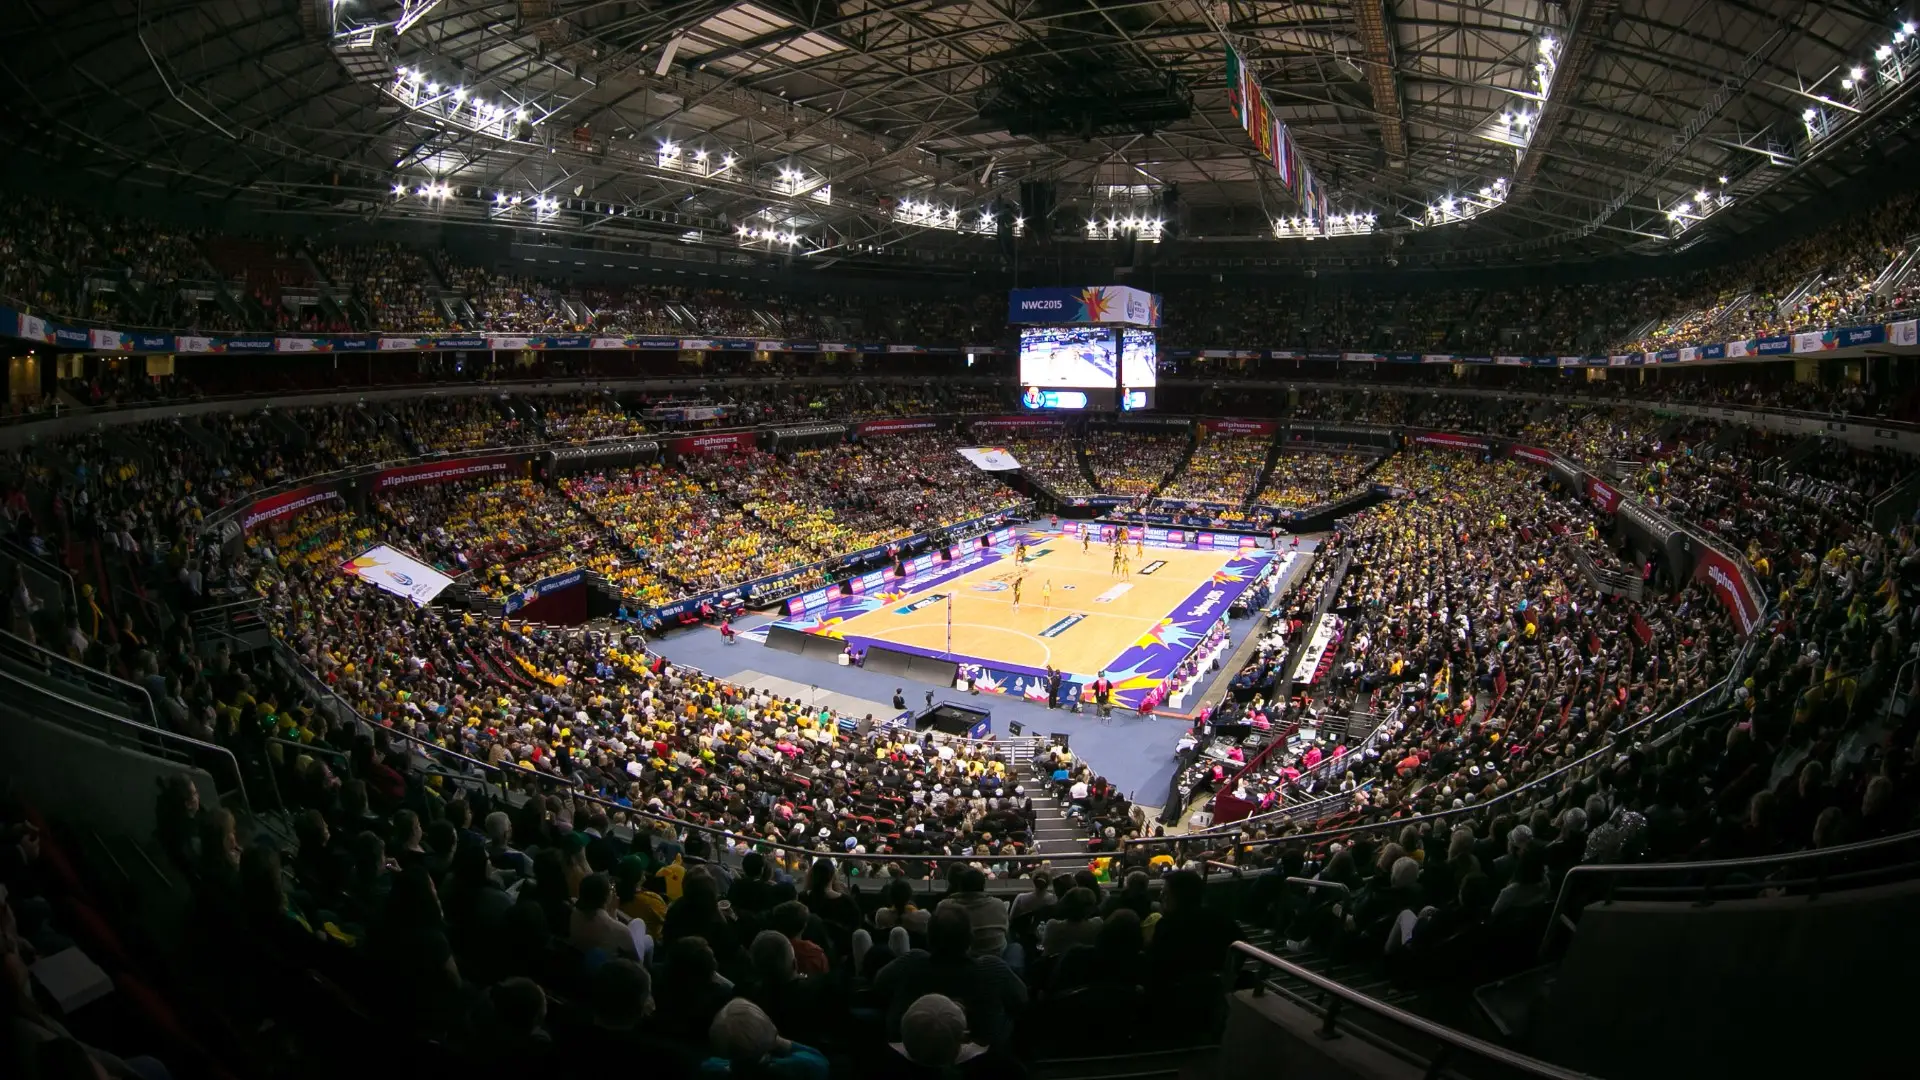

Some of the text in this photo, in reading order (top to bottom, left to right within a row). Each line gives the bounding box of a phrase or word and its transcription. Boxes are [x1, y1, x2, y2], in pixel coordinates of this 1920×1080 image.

[1021, 300, 1063, 310] NWC2015
[1217, 421, 1261, 429] allphones
[693, 436, 738, 446] allphones
[382, 463, 507, 486] allphonesarena.com.au
[245, 490, 338, 529] allphonesarena.com.au
[541, 582, 559, 592] NETBALL
[559, 577, 573, 587] WORLD
